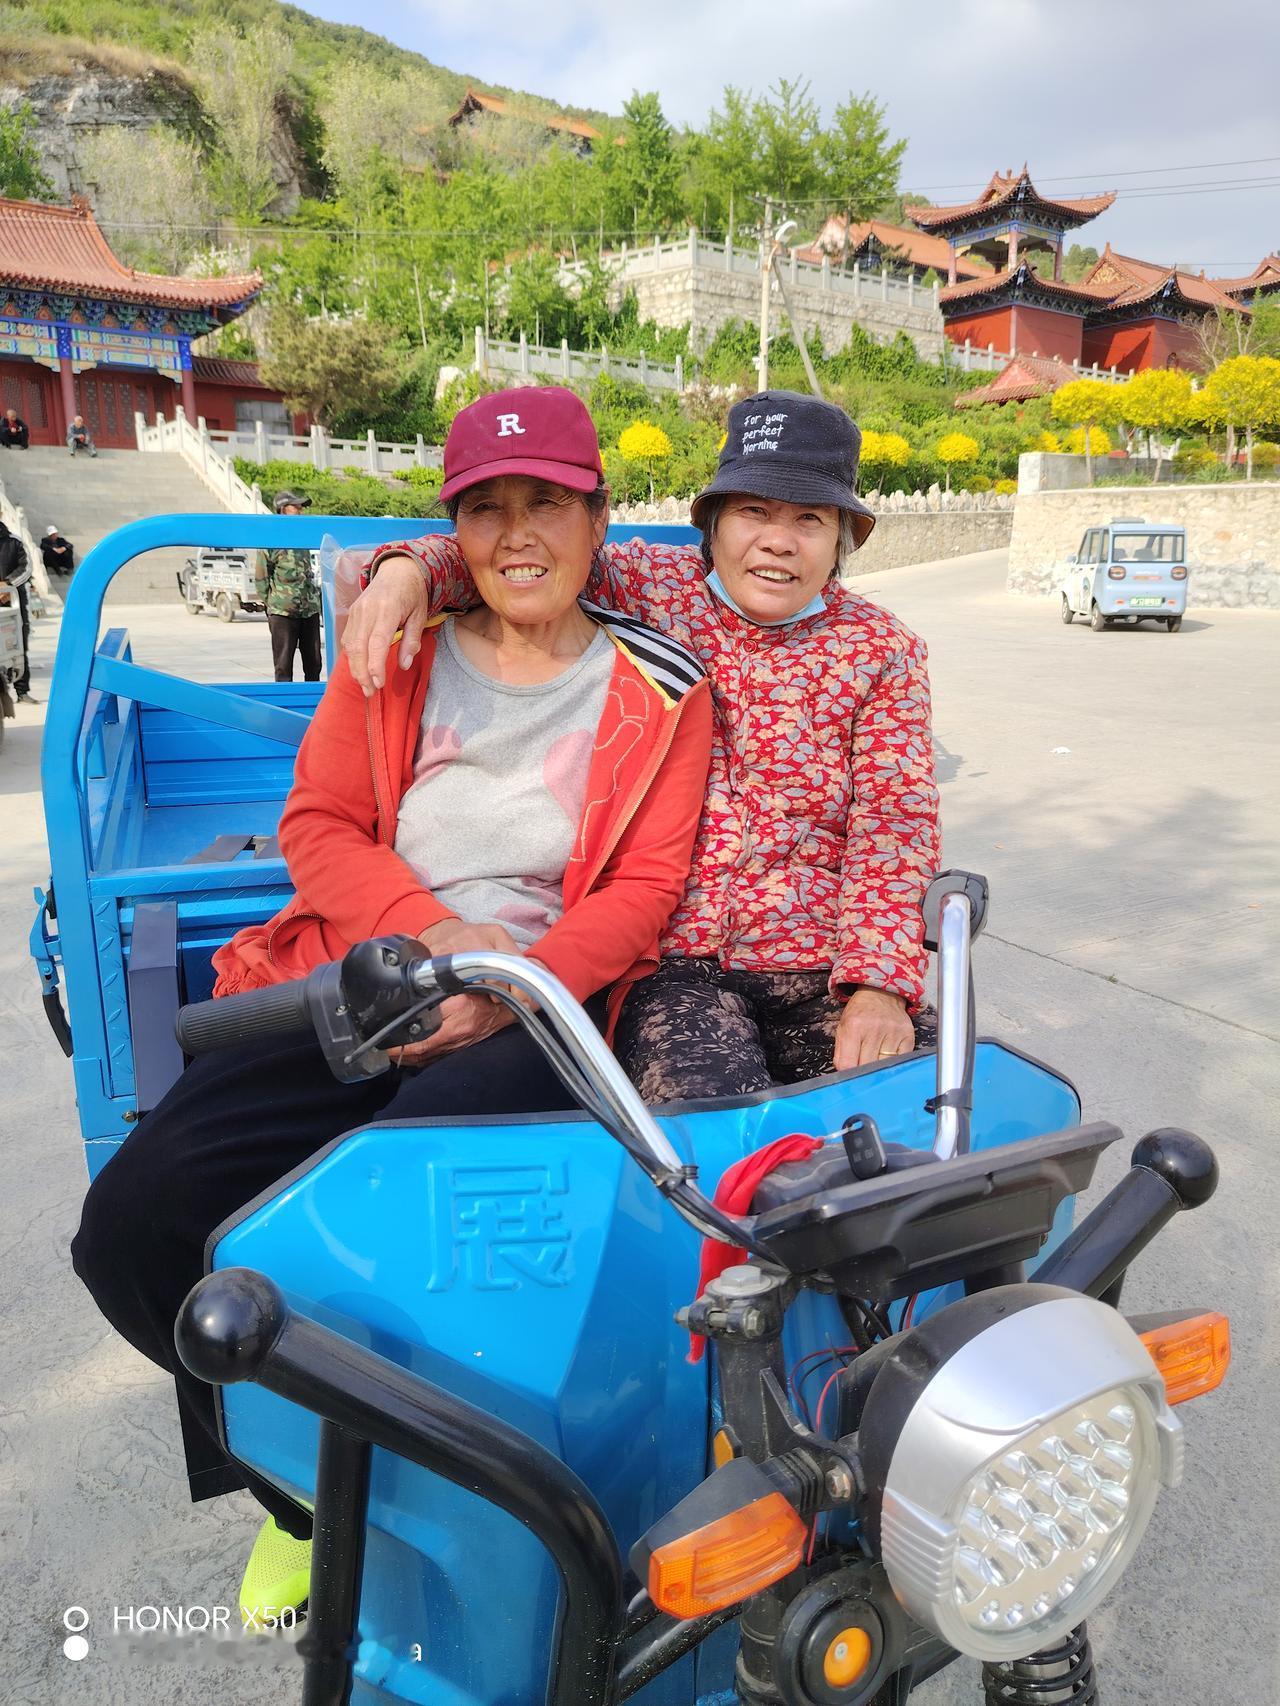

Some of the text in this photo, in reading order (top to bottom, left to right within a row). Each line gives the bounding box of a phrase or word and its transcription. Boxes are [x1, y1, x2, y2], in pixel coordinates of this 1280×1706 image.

[496, 413, 526, 437] R
[743, 413, 789, 427] For your
[742, 423, 784, 443] perfect
